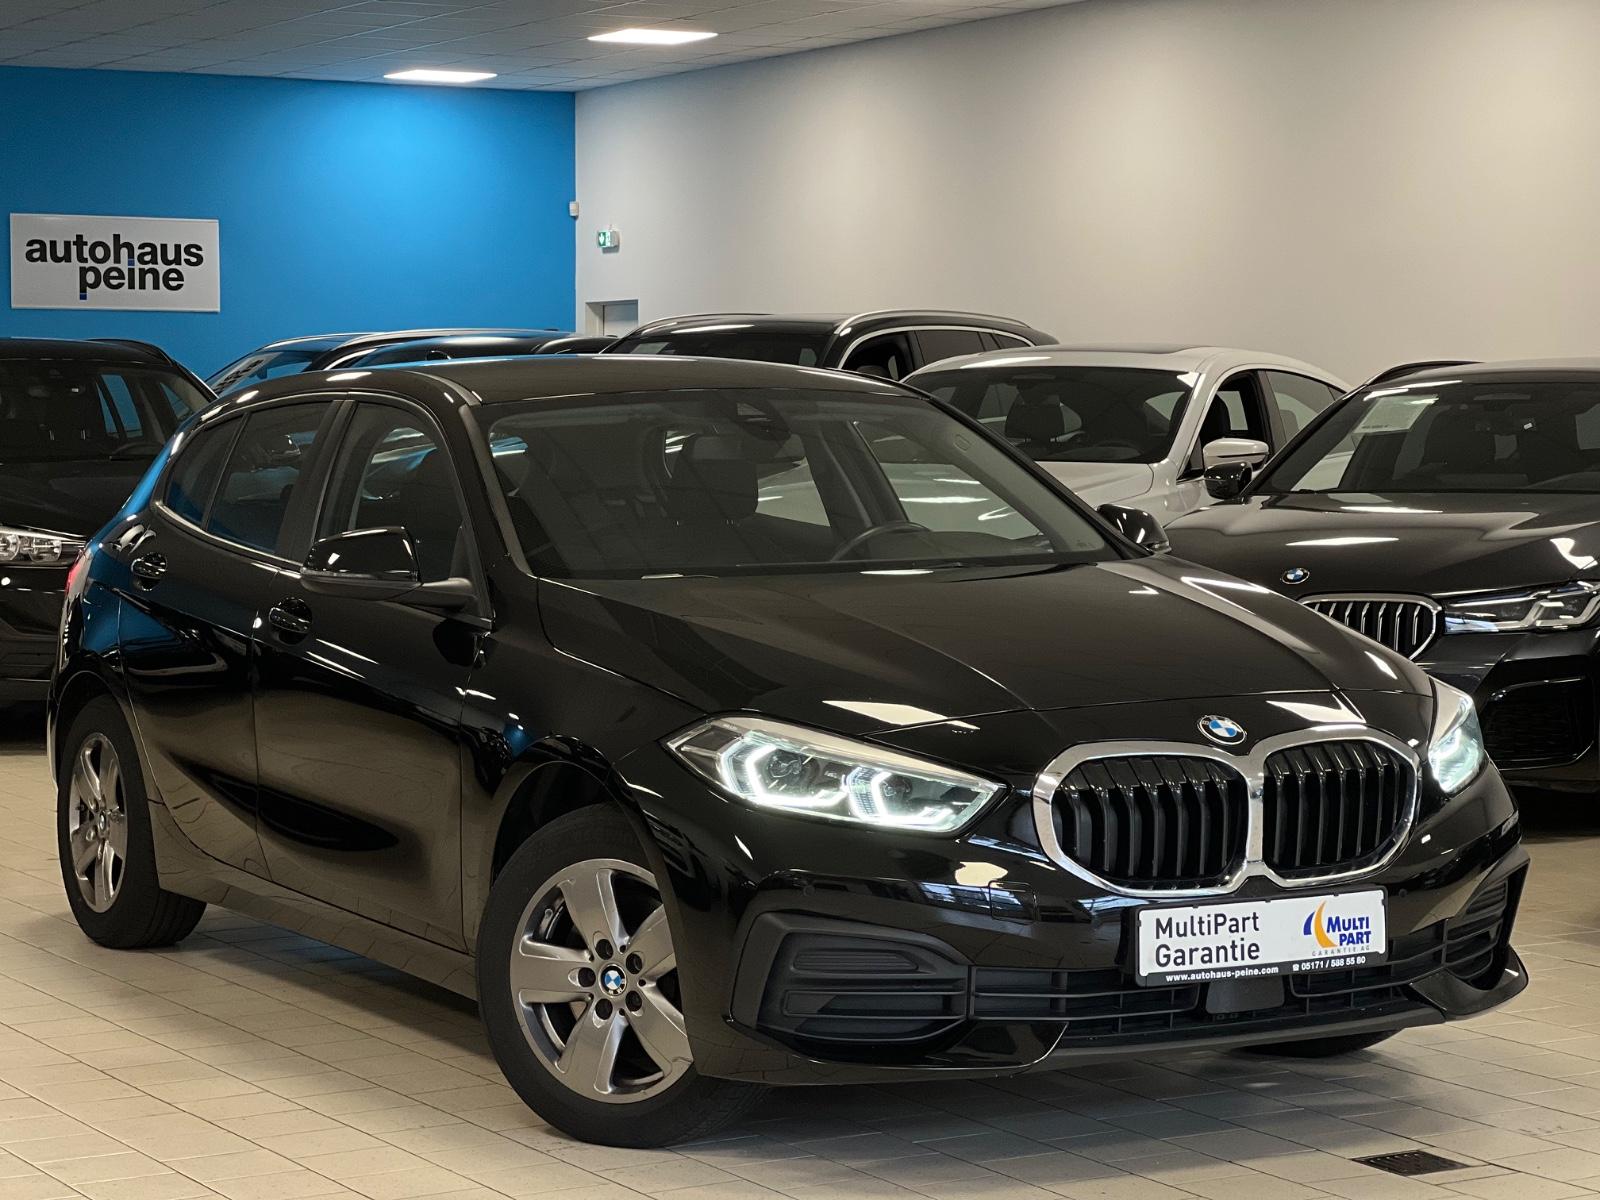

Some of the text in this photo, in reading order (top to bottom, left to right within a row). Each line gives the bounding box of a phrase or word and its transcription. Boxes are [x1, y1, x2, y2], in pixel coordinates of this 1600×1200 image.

[25, 234, 204, 267] autohaus
[79, 266, 185, 300] peine
[1155, 911, 1260, 940] MultiPart
[1326, 915, 1370, 933] MULTI
[1339, 930, 1372, 947] PART
[1155, 937, 1260, 968] Garantie
[1165, 965, 1279, 982] www.autohaus-peine.com
[1301, 960, 1324, 971] 05171
